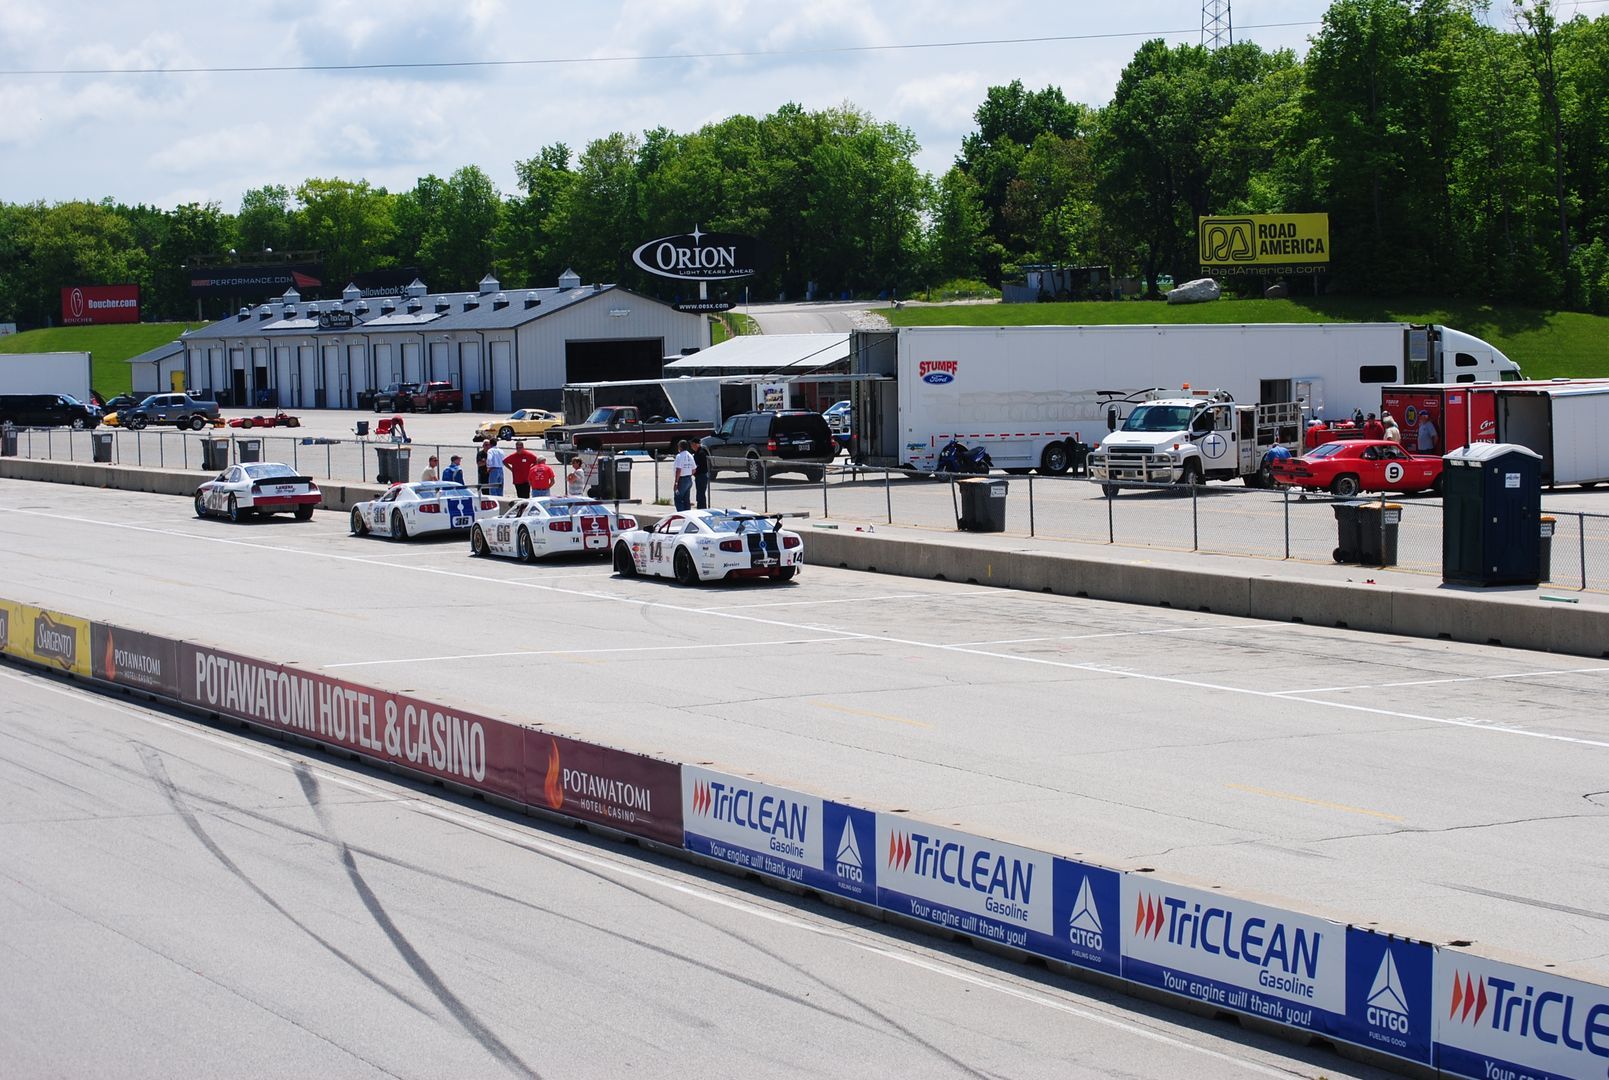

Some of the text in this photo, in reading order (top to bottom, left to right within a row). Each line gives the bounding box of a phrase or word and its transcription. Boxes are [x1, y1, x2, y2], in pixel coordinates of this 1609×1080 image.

[1258, 223, 1297, 239] ROAD
[656, 242, 737, 270] ORION
[1260, 238, 1325, 255] AMERICA
[1200, 265, 1326, 276] RoadAmerica.com
[360, 286, 399, 297] ellowbook
[88, 299, 137, 309] Boucher.com
[919, 361, 958, 377] STUMPF
[929, 375, 948, 383] Ford
[1389, 467, 1399, 479] 9
[373, 507, 386, 523] 36
[455, 517, 469, 526] 36
[496, 525, 511, 542] 66
[649, 541, 663, 562] 14
[793, 552, 803, 563] 14
[37, 623, 72, 658] SARGENTO
[114, 649, 161, 676] POTAWATOMI
[195, 651, 486, 783] POTAWATOMI HOTEL & CASINO
[563, 768, 651, 812] POTAWATOMI
[580, 798, 602, 815] HOTEL
[608, 806, 635, 823] CASINO
[711, 781, 808, 843] TriCLEAN
[770, 836, 804, 859] Gasoline
[709, 841, 804, 881] Your engine will thank you!
[911, 833, 1034, 905] TriCLEAN
[836, 863, 863, 883] CITGO
[985, 896, 1028, 922] Gasoline
[910, 899, 1027, 946] Your engine will thank you!
[1069, 928, 1103, 951] CITGO
[1164, 896, 1321, 979] TriCLEAN
[1071, 949, 1102, 963] FUELING GOOD
[1258, 970, 1314, 998] Gasoline
[1162, 971, 1312, 1026] Your engine will thank you!
[1367, 1006, 1409, 1034] CITGO
[1369, 1031, 1407, 1048] FUELING GOOD
